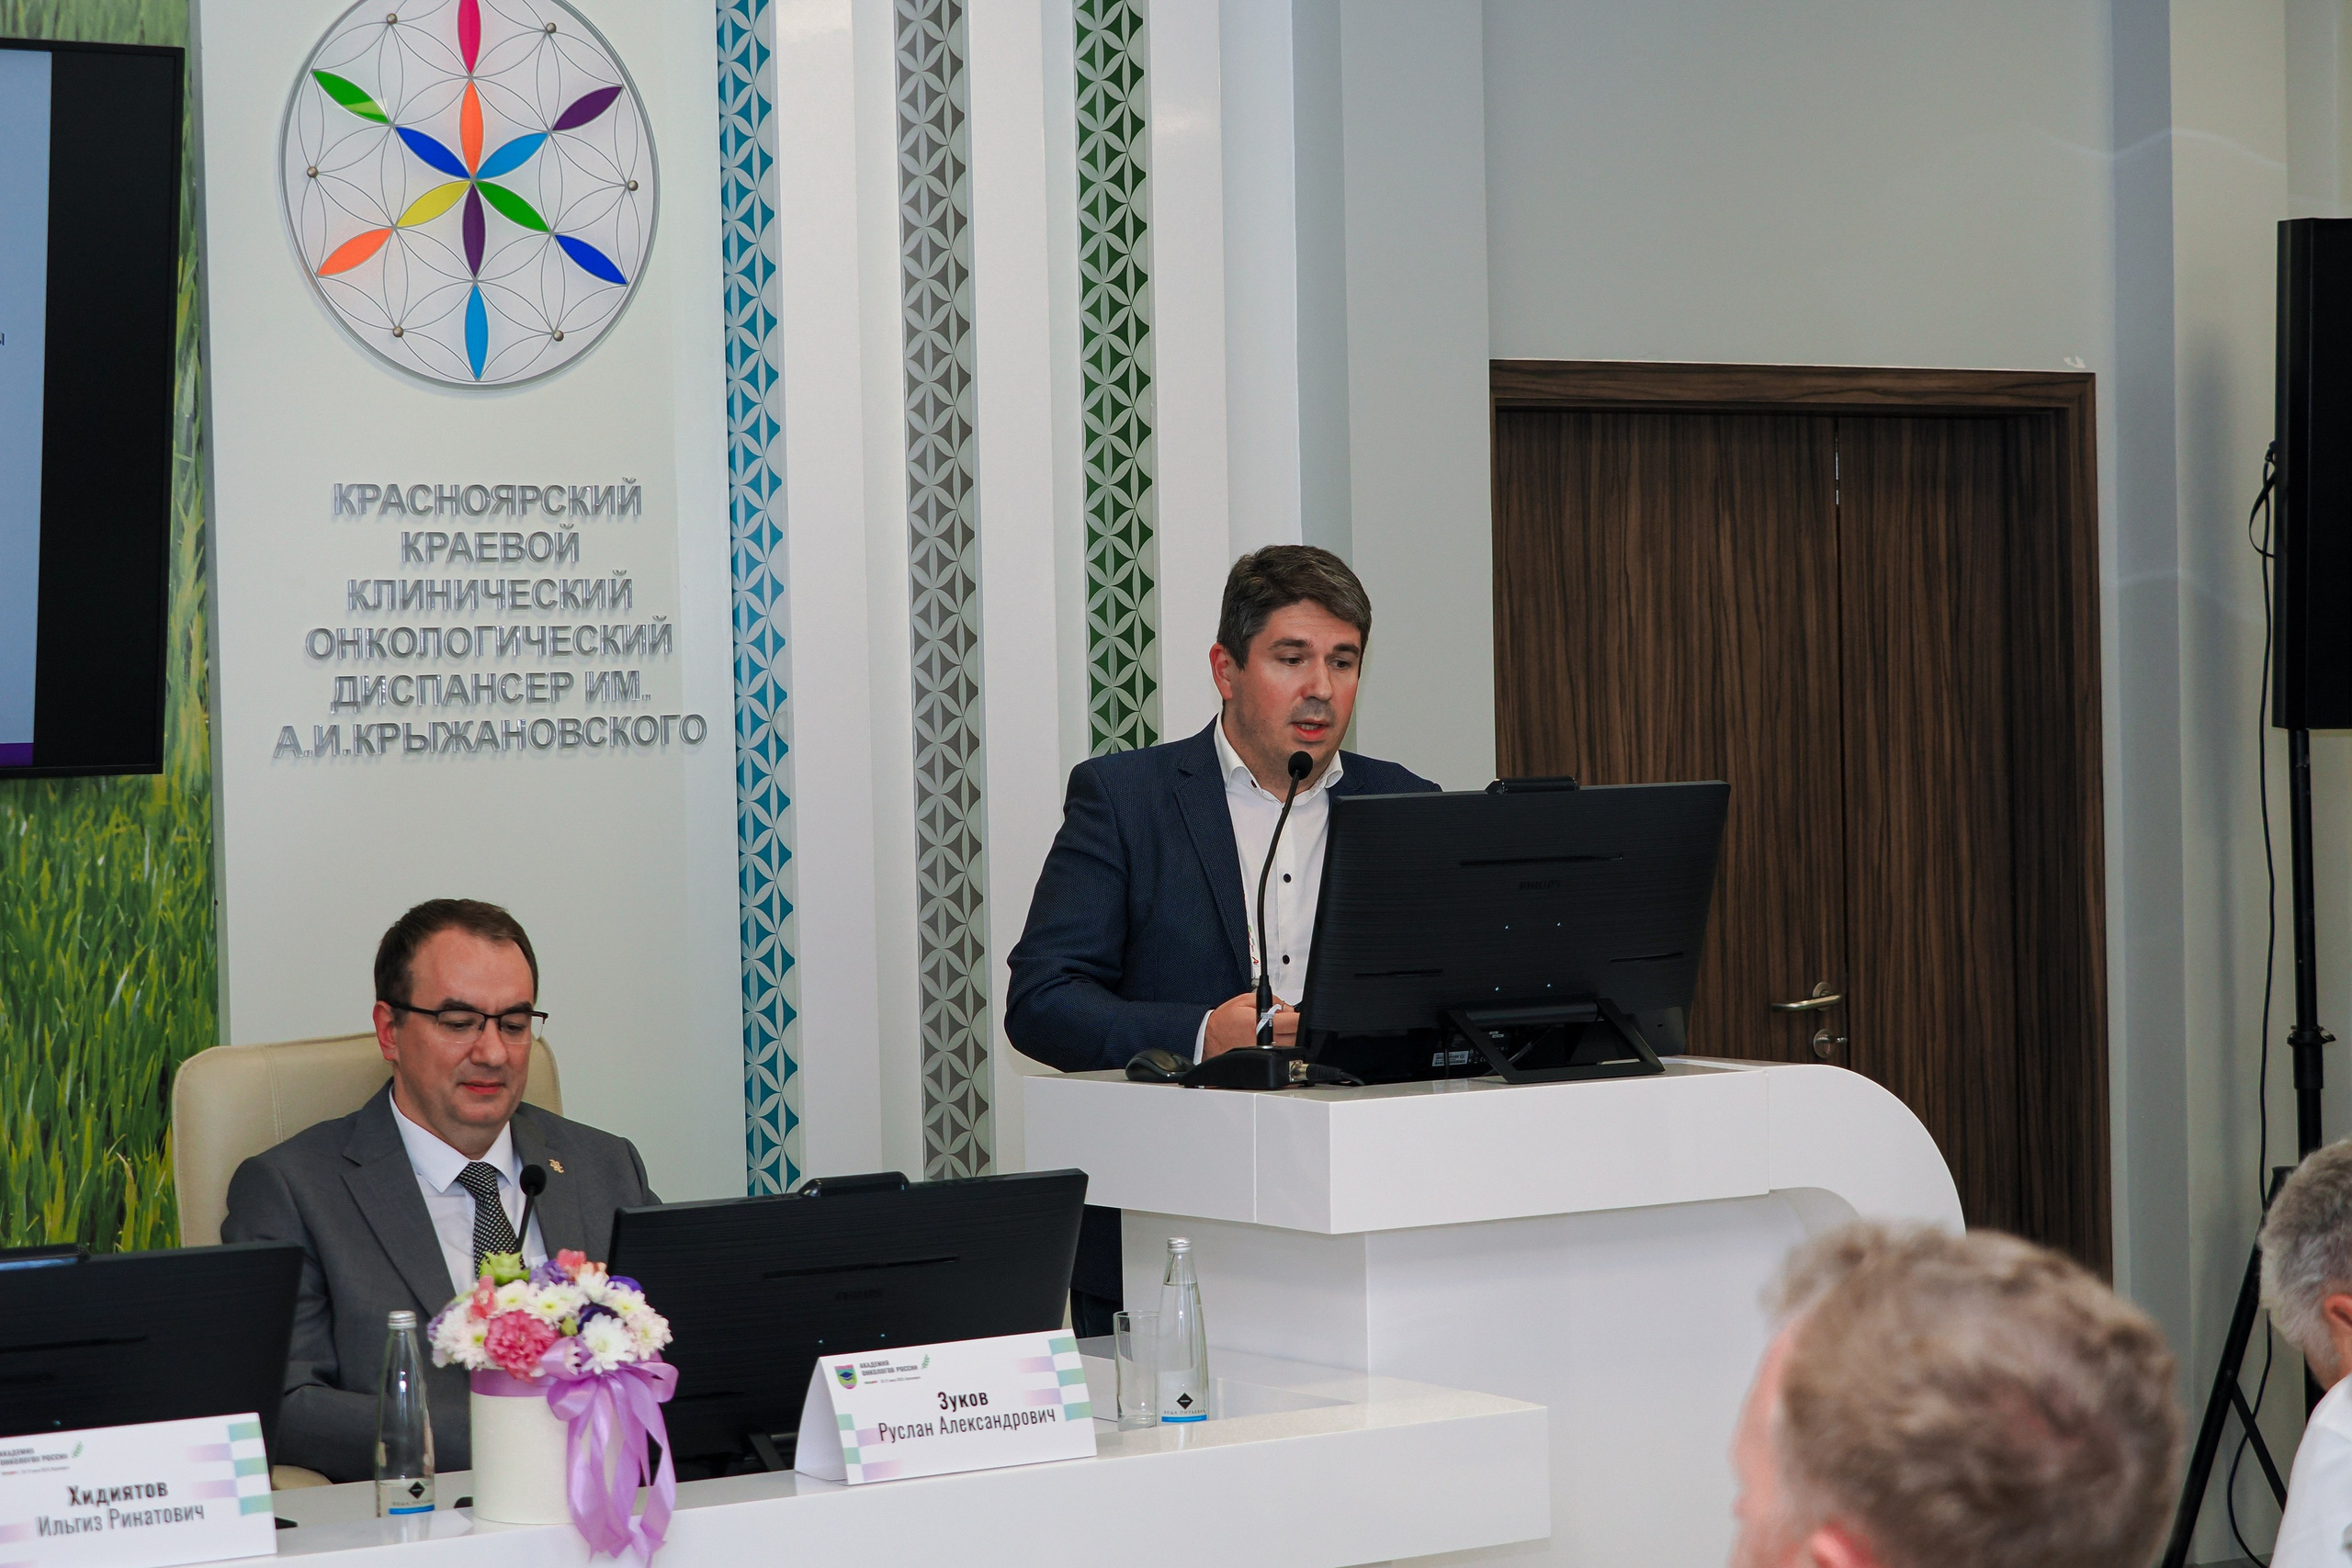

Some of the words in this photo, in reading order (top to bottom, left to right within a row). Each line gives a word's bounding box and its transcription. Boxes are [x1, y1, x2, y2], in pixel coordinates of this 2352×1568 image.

[333, 477, 642, 516] КРАСНОЯРСКИЙ
[401, 523, 580, 563] КРАЕВОЙ
[347, 570, 633, 610] КЛИНИЧЕСКИЙ
[305, 615, 673, 660] ОНКОЛОГИЧЕСКИЙ
[331, 671, 574, 714] ДИСПАНСЕР
[585, 670, 651, 701] ИМ.
[274, 714, 707, 758] А.И.КРЫЖАНОВСКОГО
[859, 1359, 889, 1368] АКАДЕМИЯ
[862, 1367, 895, 1376] ОНКОЛОГОВ
[937, 1391, 989, 1412] Зуков
[878, 1421, 933, 1443] Руслан
[940, 1408, 1056, 1435] Александрович
[67, 1482, 168, 1506] Хидиятов
[37, 1515, 103, 1538] Ильгиз
[109, 1504, 205, 1529] Ринатович
